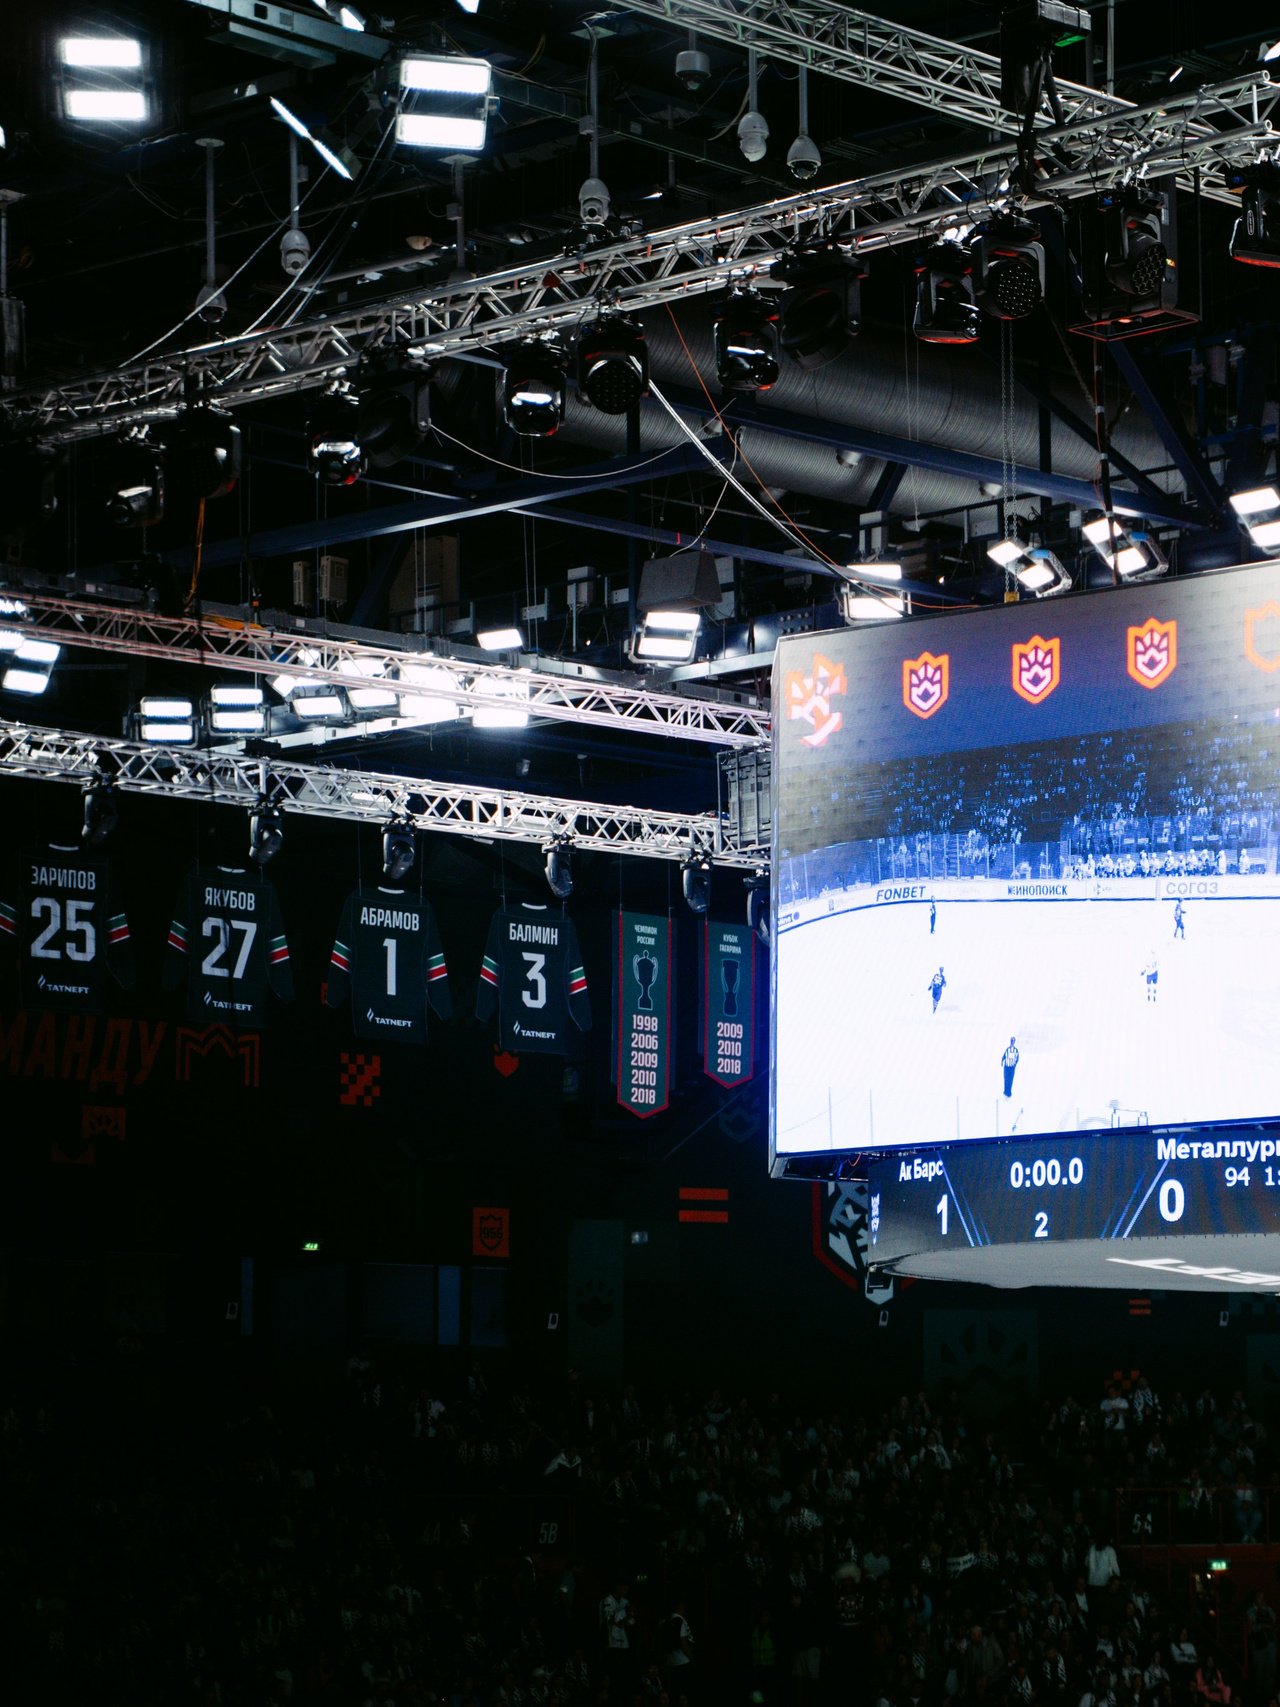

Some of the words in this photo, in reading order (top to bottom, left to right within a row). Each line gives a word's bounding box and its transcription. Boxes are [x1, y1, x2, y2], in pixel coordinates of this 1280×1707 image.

[31, 865, 96, 890] ЗАРИПОВ
[204, 886, 256, 911] ЯКУБОВ
[876, 886, 926, 901] FONBET
[30, 896, 97, 962] 25
[360, 906, 420, 932] АБРАМОВ
[509, 922, 559, 945] БАЛМИН
[201, 916, 258, 979] 27
[382, 938, 397, 996] 1
[46, 983, 90, 994] TATNEFT
[521, 952, 547, 1009] 3
[212, 1000, 252, 1011] TATNEFT
[374, 1016, 412, 1028] TATNEFT
[632, 1014, 658, 1032] 1998
[716, 1021, 743, 1039] 2009
[521, 1029, 556, 1040] TATNEFT
[631, 1032, 659, 1050] 2006
[717, 1040, 742, 1057] 2010
[630, 1051, 658, 1068] 2009
[717, 1057, 741, 1075] 2018
[631, 1069, 656, 1087] 2010
[631, 1087, 656, 1105] 2018
[899, 1160, 913, 1182] Ак
[914, 1157, 943, 1181] Барс
[1010, 1158, 1083, 1188] 0:00.0
[1225, 1168, 1250, 1187] 94
[1159, 1179, 1185, 1222] 0
[937, 1194, 948, 1235] 1
[1035, 1211, 1048, 1238] 2
[539, 1521, 559, 1544] 5B
